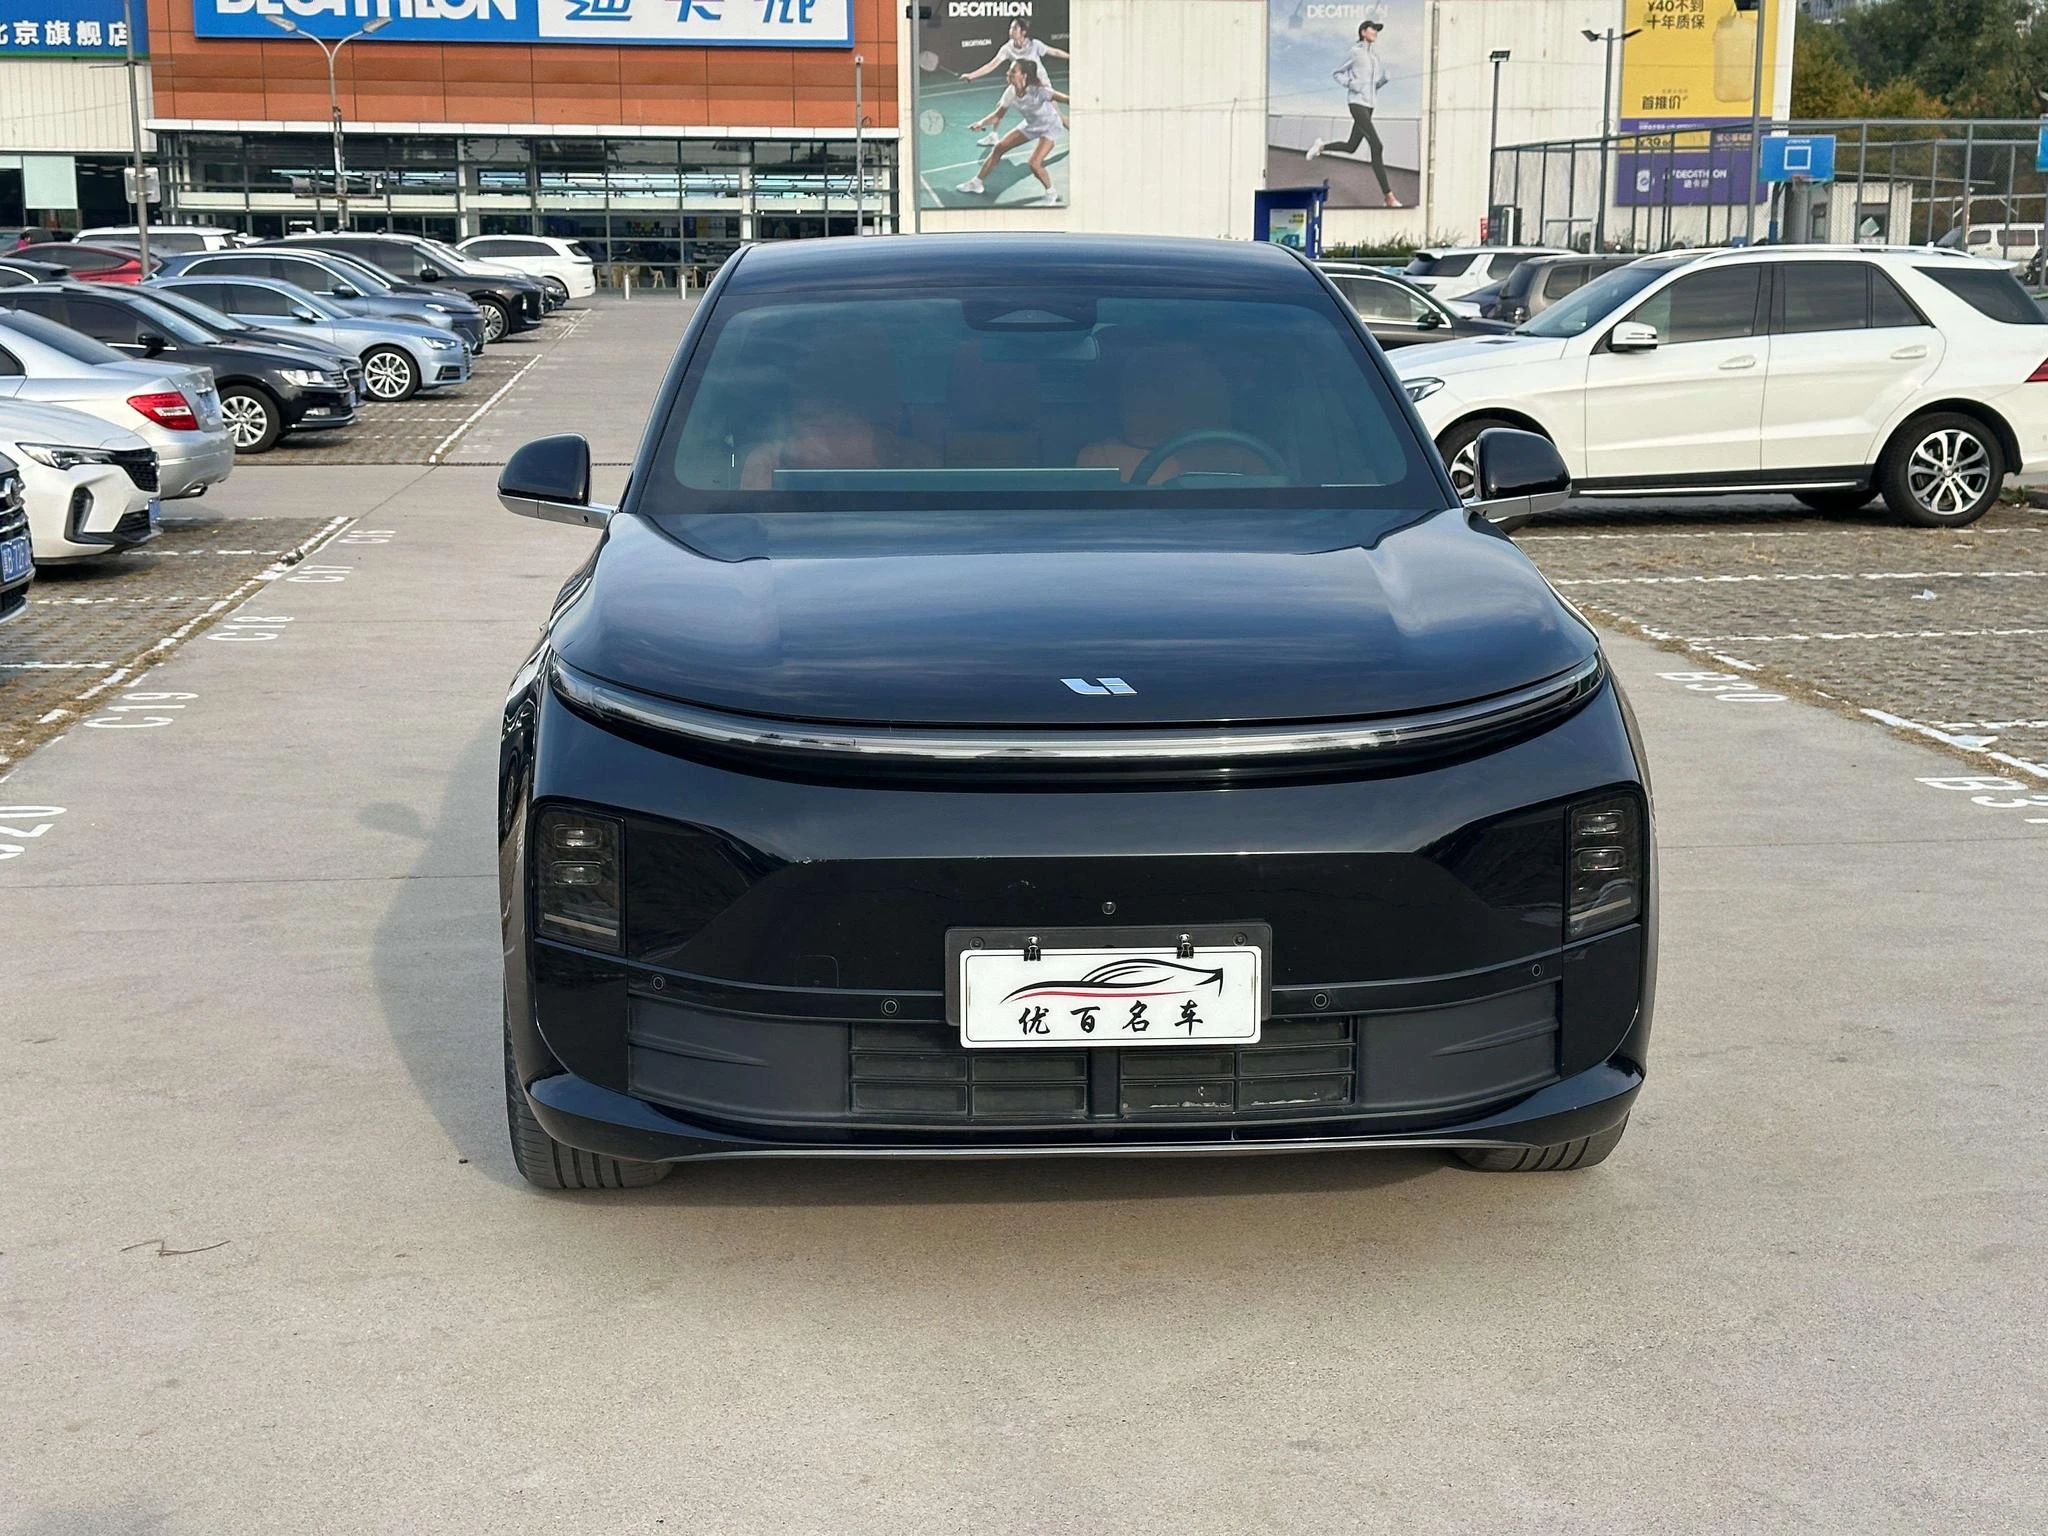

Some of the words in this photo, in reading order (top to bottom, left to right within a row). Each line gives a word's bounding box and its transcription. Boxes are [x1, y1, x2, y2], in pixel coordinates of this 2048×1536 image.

[949, 1, 1033, 17] DECATHLON
[1646, 14, 1705, 30] 十年质保
[1675, 169, 1728, 180] DECATHON
[206, 616, 295, 641] C18
[1654, 671, 1790, 702] B30
[83, 691, 199, 729] C19
[1914, 776, 2048, 824] B3
[1018, 999, 1204, 1036] 优百名车
